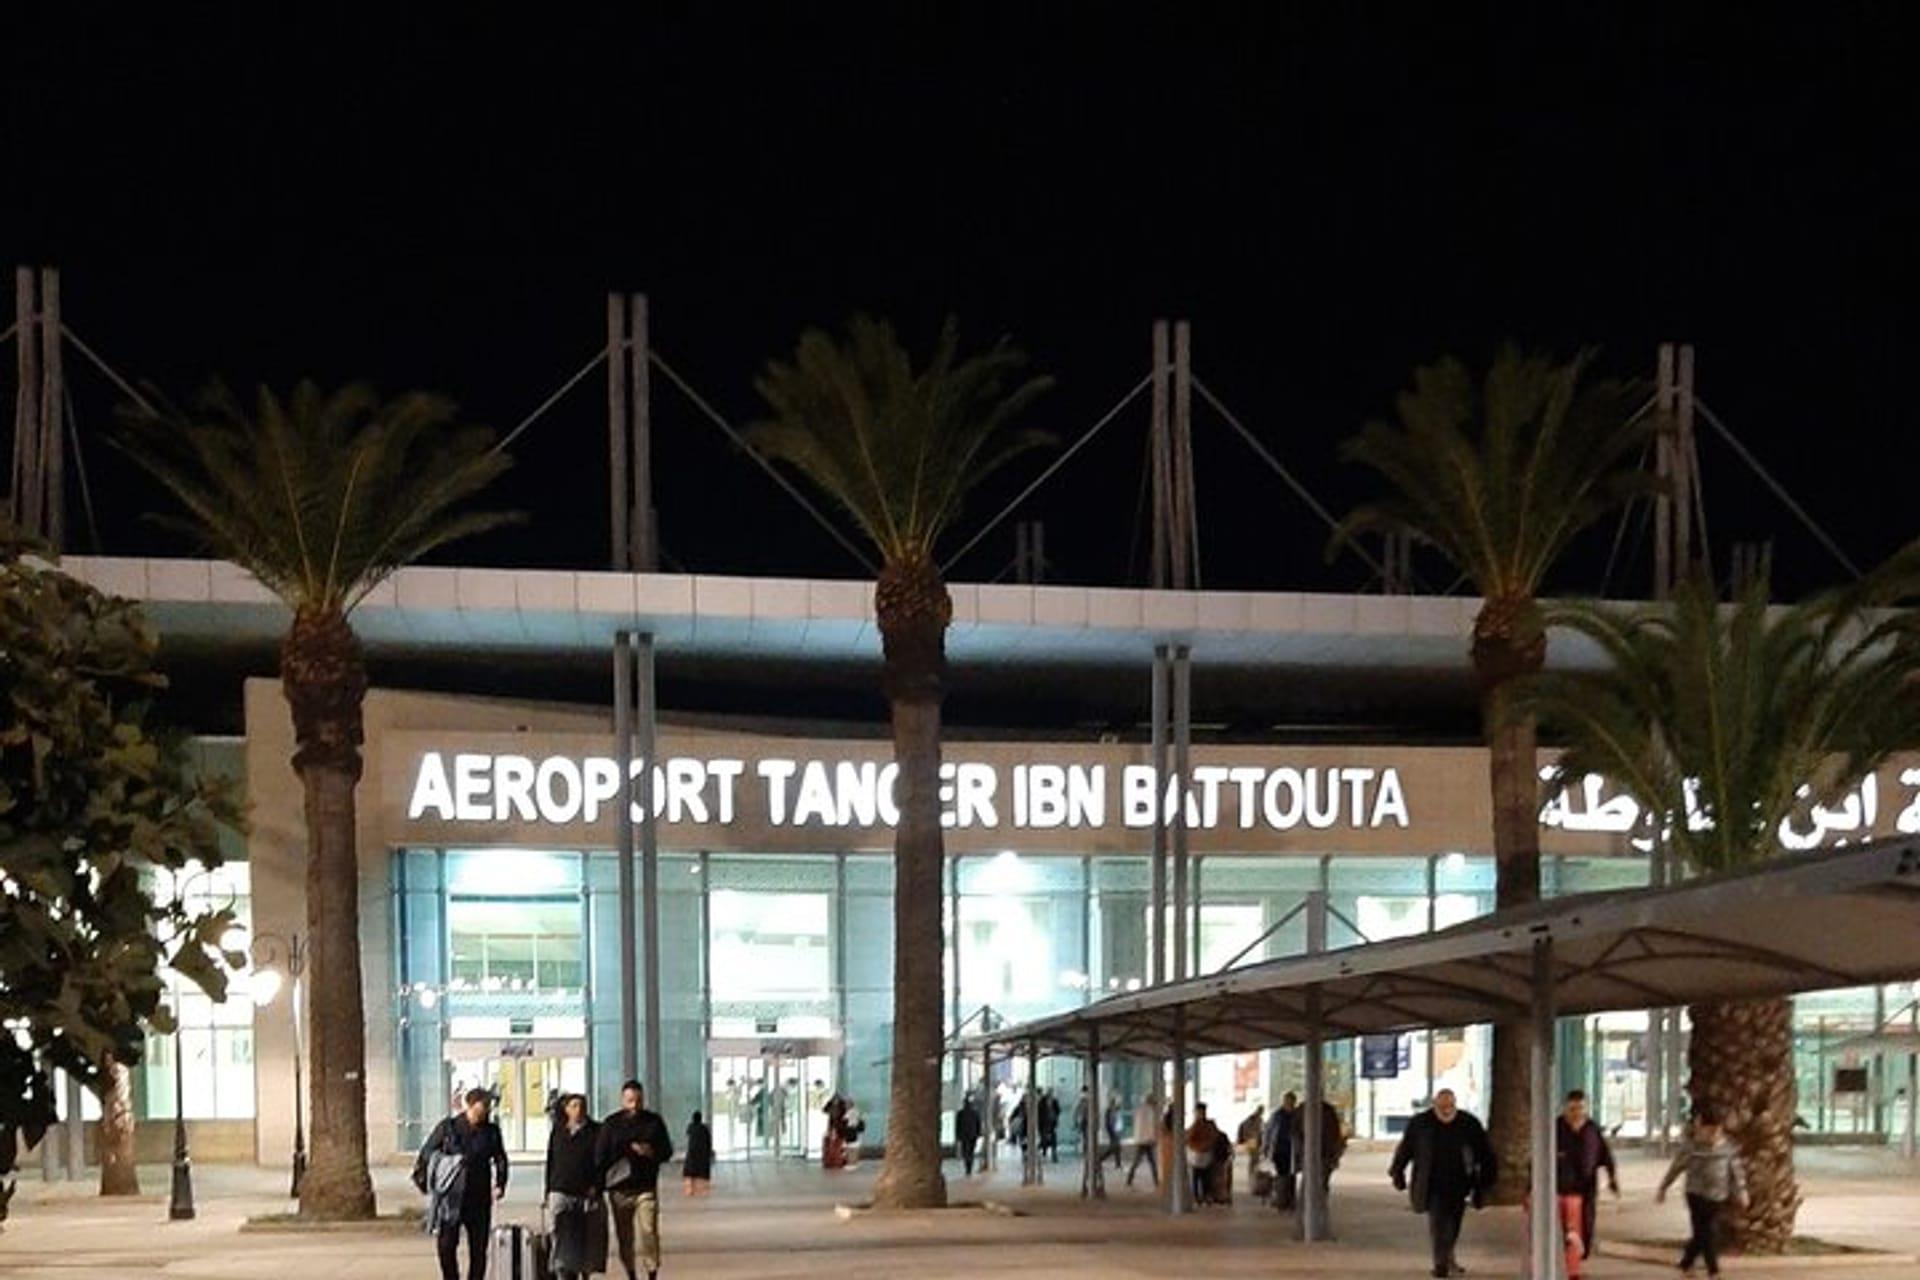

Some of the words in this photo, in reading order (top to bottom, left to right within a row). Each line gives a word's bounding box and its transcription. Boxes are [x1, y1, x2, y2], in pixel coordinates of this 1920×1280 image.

[407, 751, 744, 825] AEROPORT
[1013, 764, 1106, 829] IBN
[1122, 764, 1410, 830] BATTOUTA
